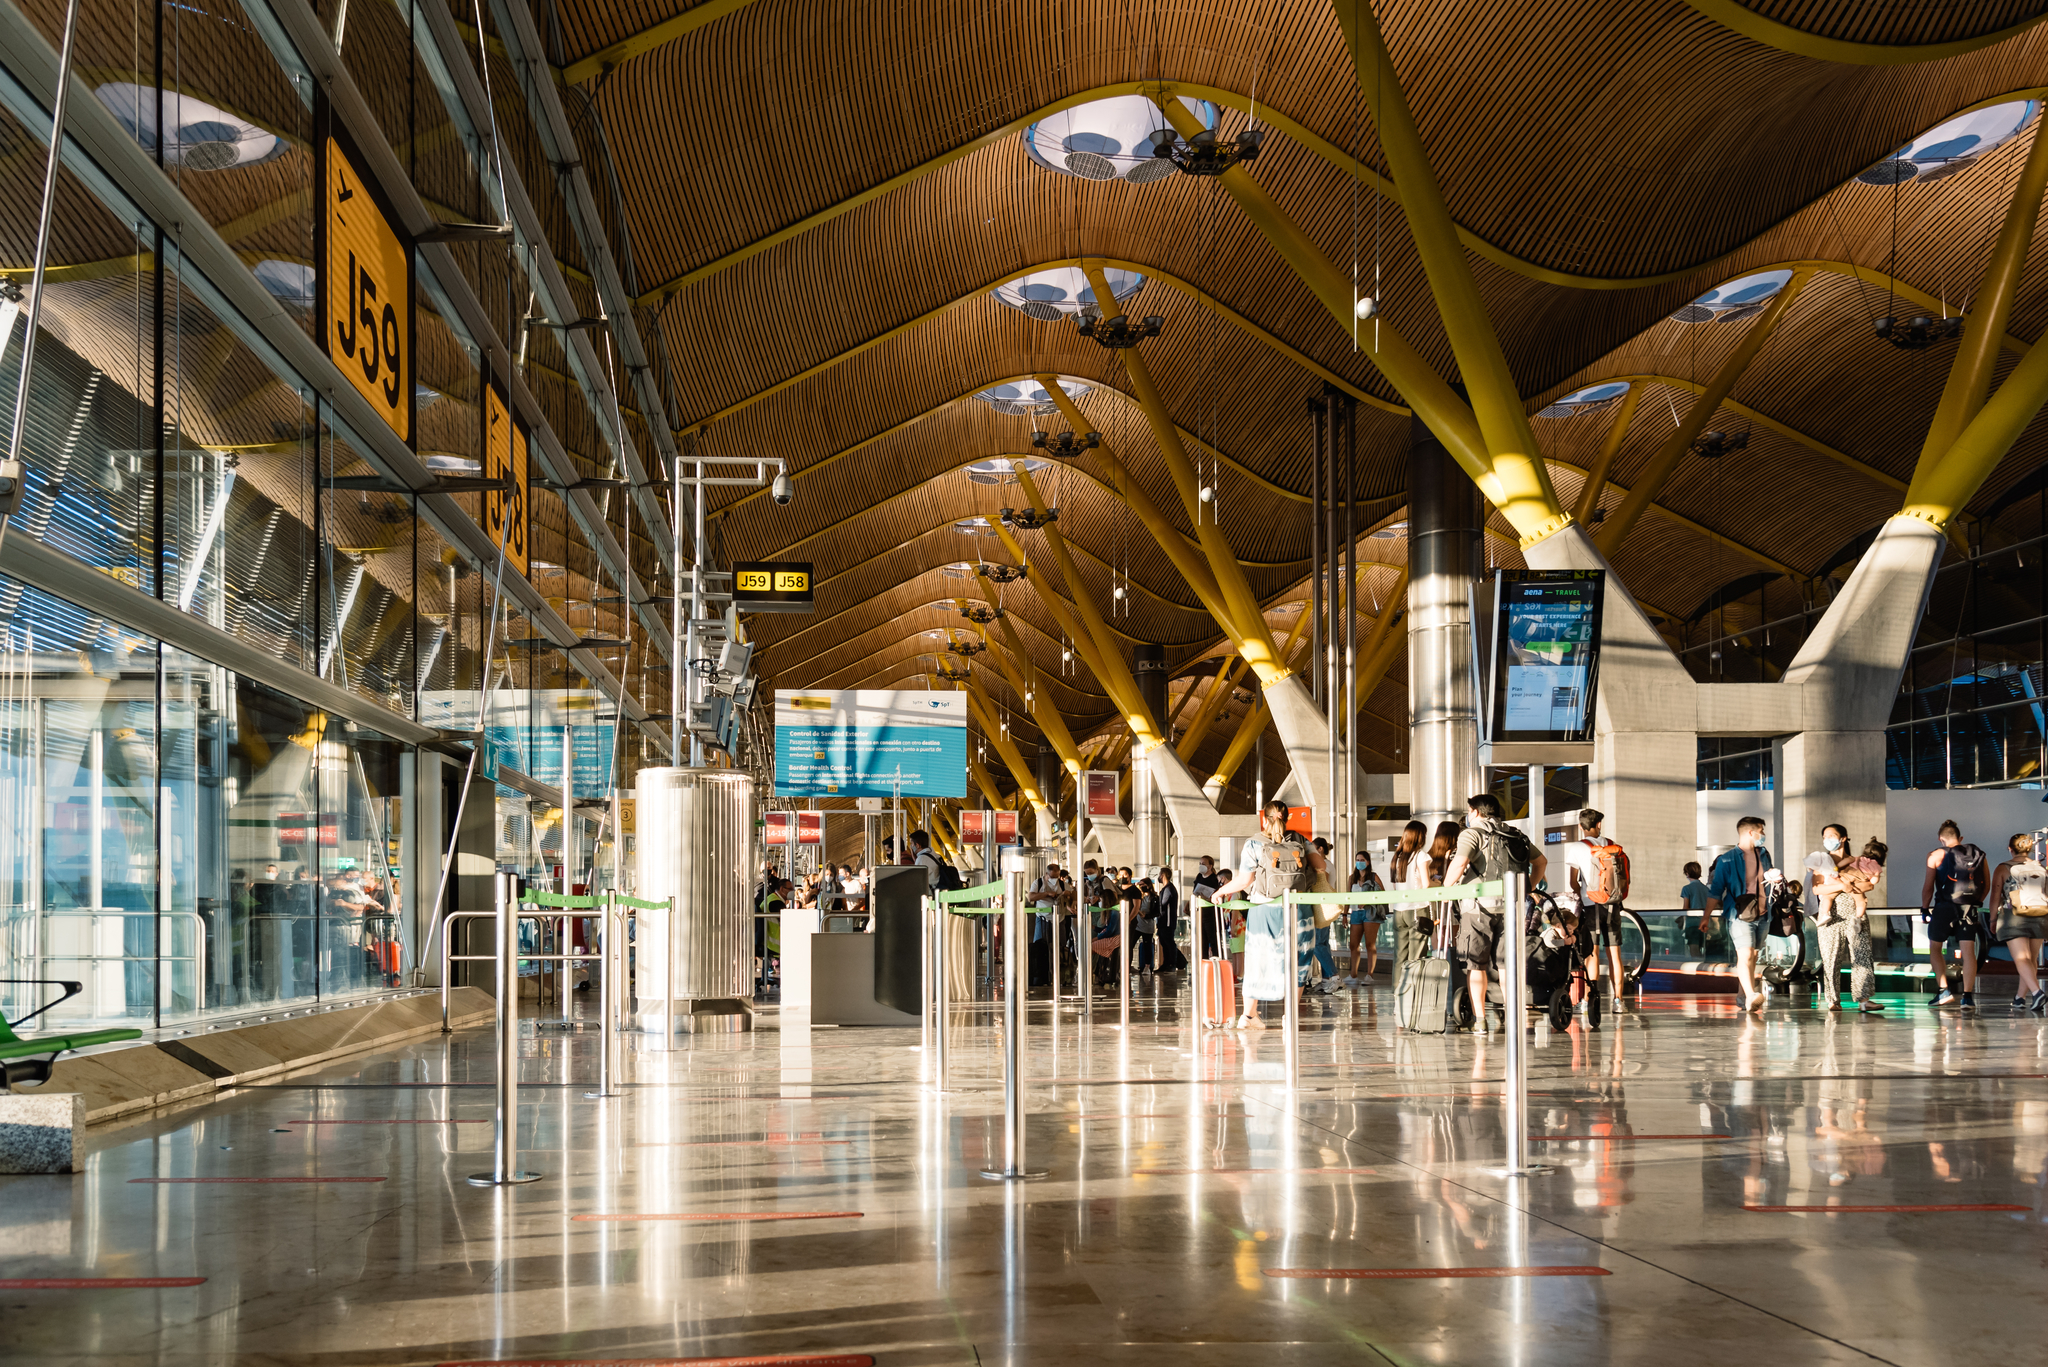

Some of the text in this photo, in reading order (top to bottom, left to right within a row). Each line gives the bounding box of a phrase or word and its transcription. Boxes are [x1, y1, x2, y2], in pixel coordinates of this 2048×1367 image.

[337, 248, 400, 410] J59
[741, 575, 804, 588] J59 J58
[963, 828, 982, 836] 26-32
